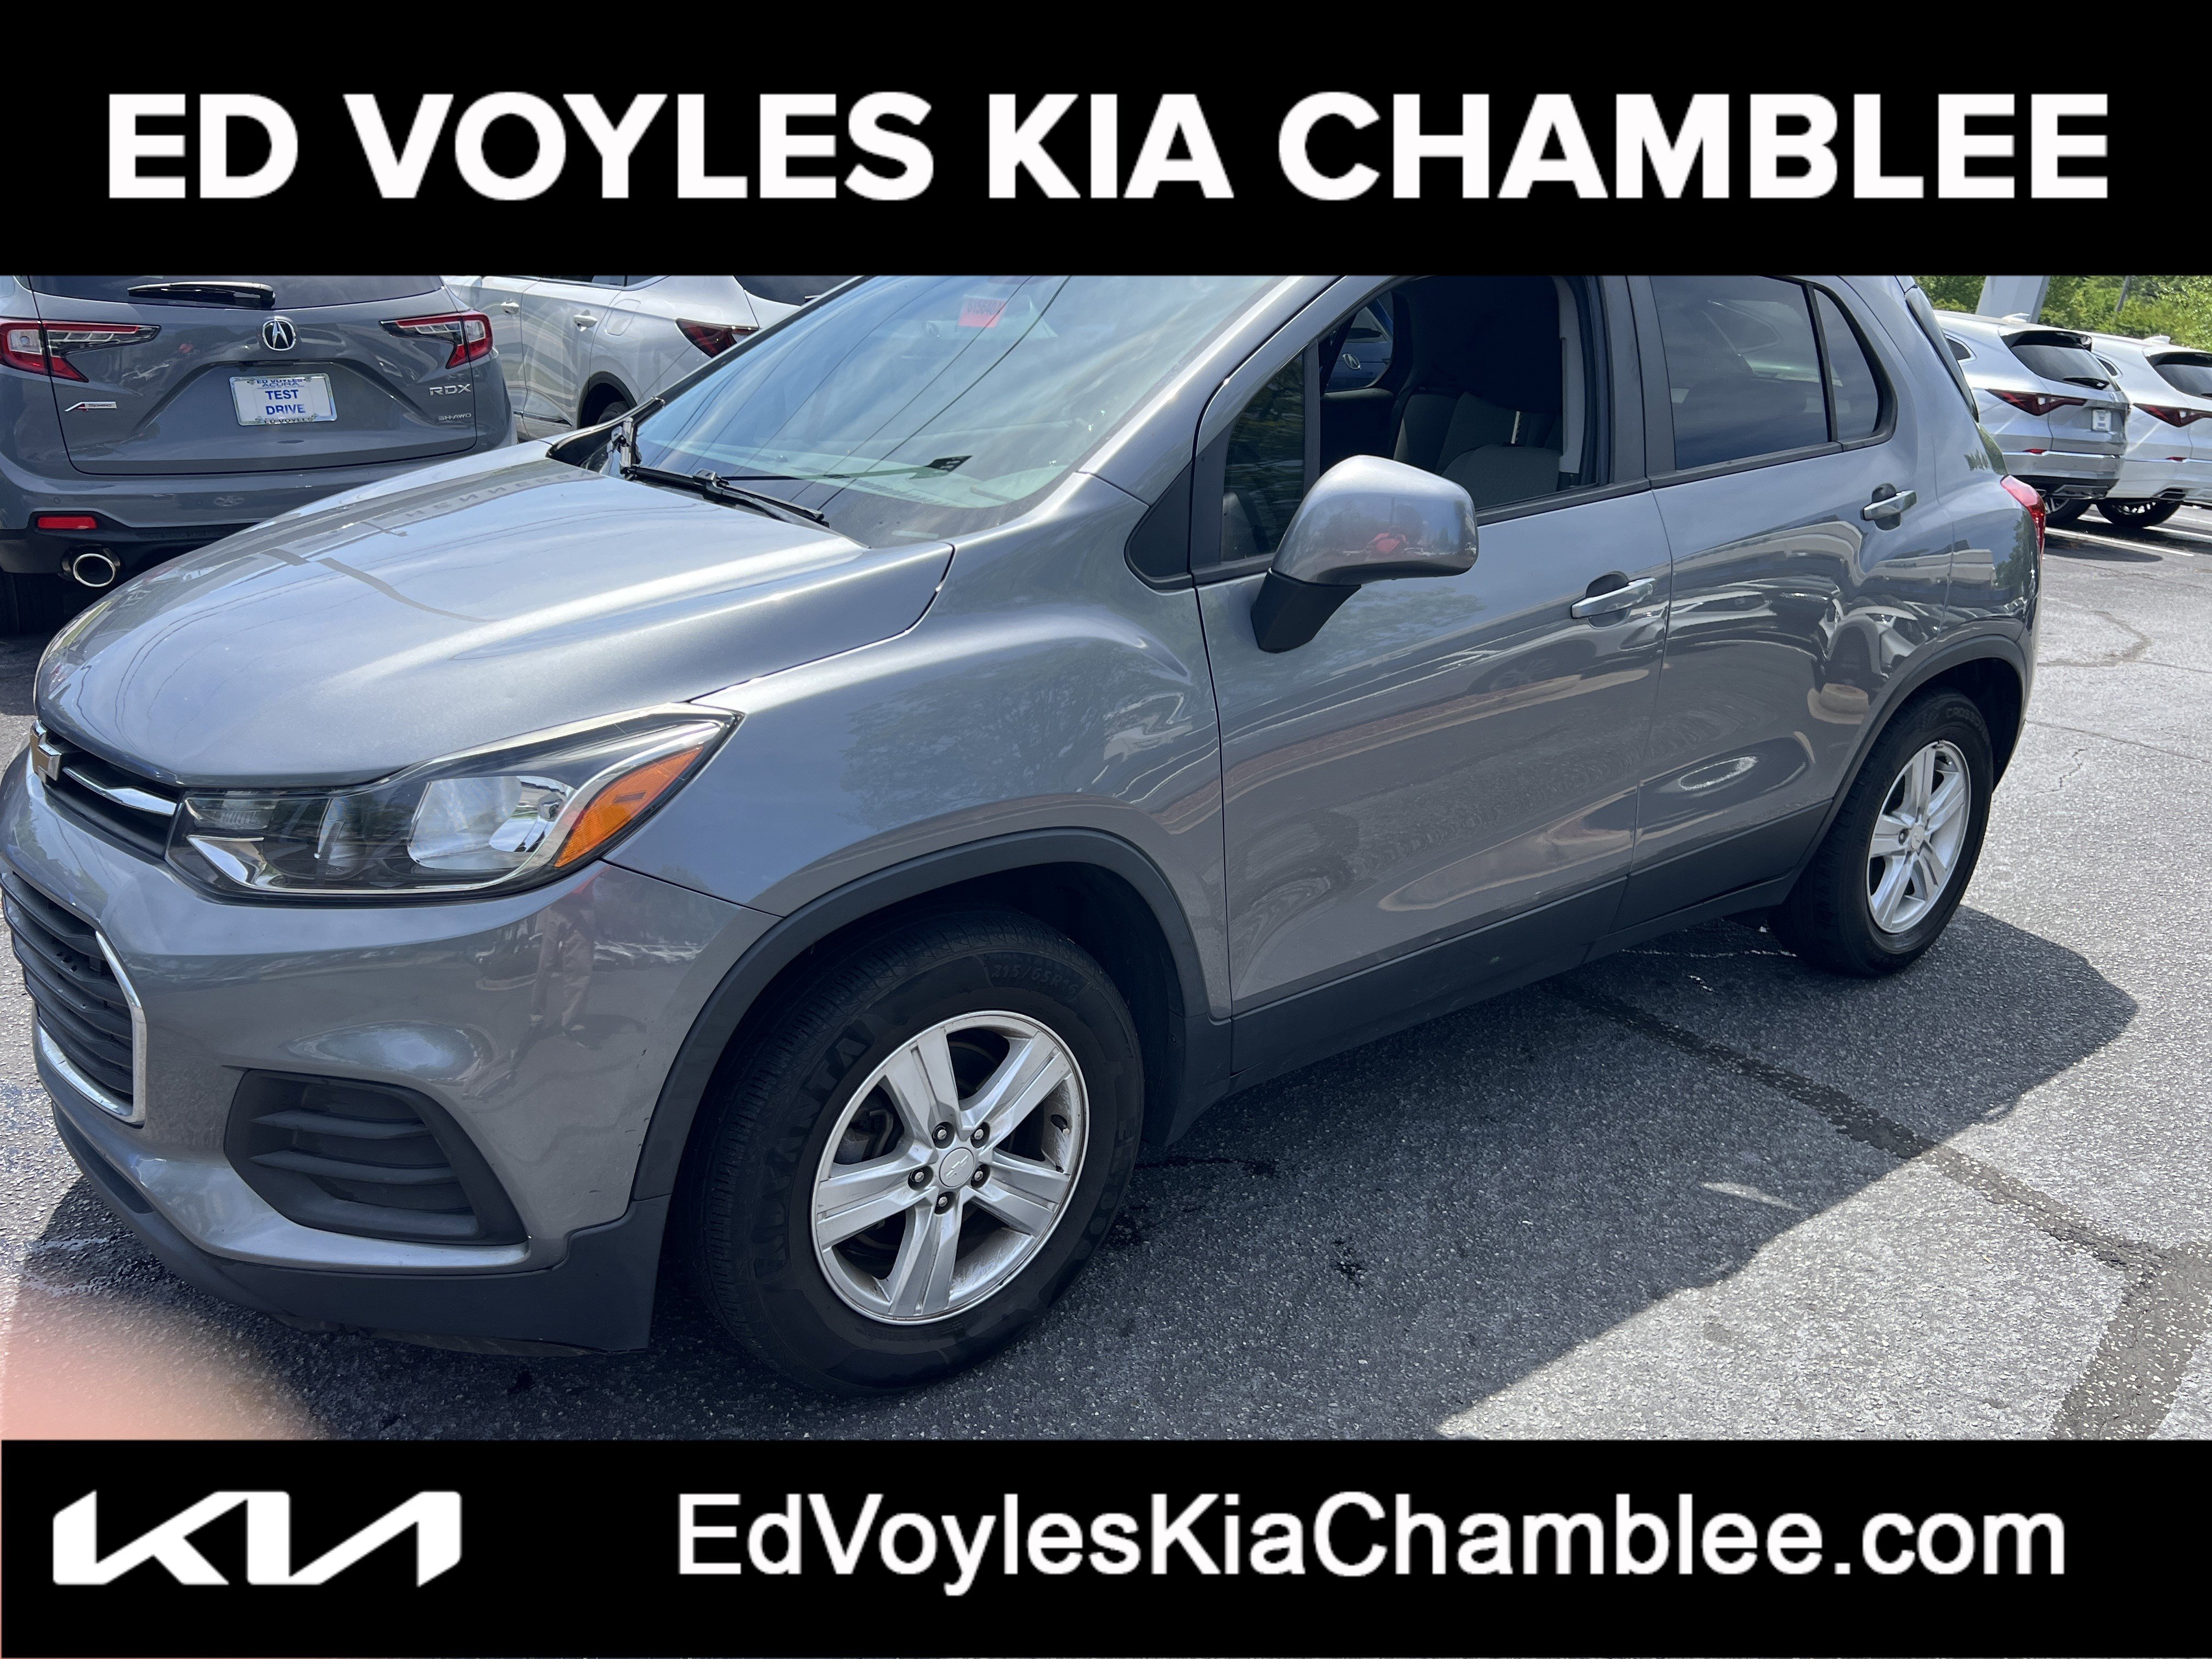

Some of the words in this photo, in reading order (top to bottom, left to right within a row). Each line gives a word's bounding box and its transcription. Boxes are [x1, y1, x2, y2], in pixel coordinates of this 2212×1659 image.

[265, 389, 298, 400] TEST
[429, 383, 472, 396] RDX
[266, 403, 306, 415] DRIVE
[991, 964, 1079, 995] 215/65R16
